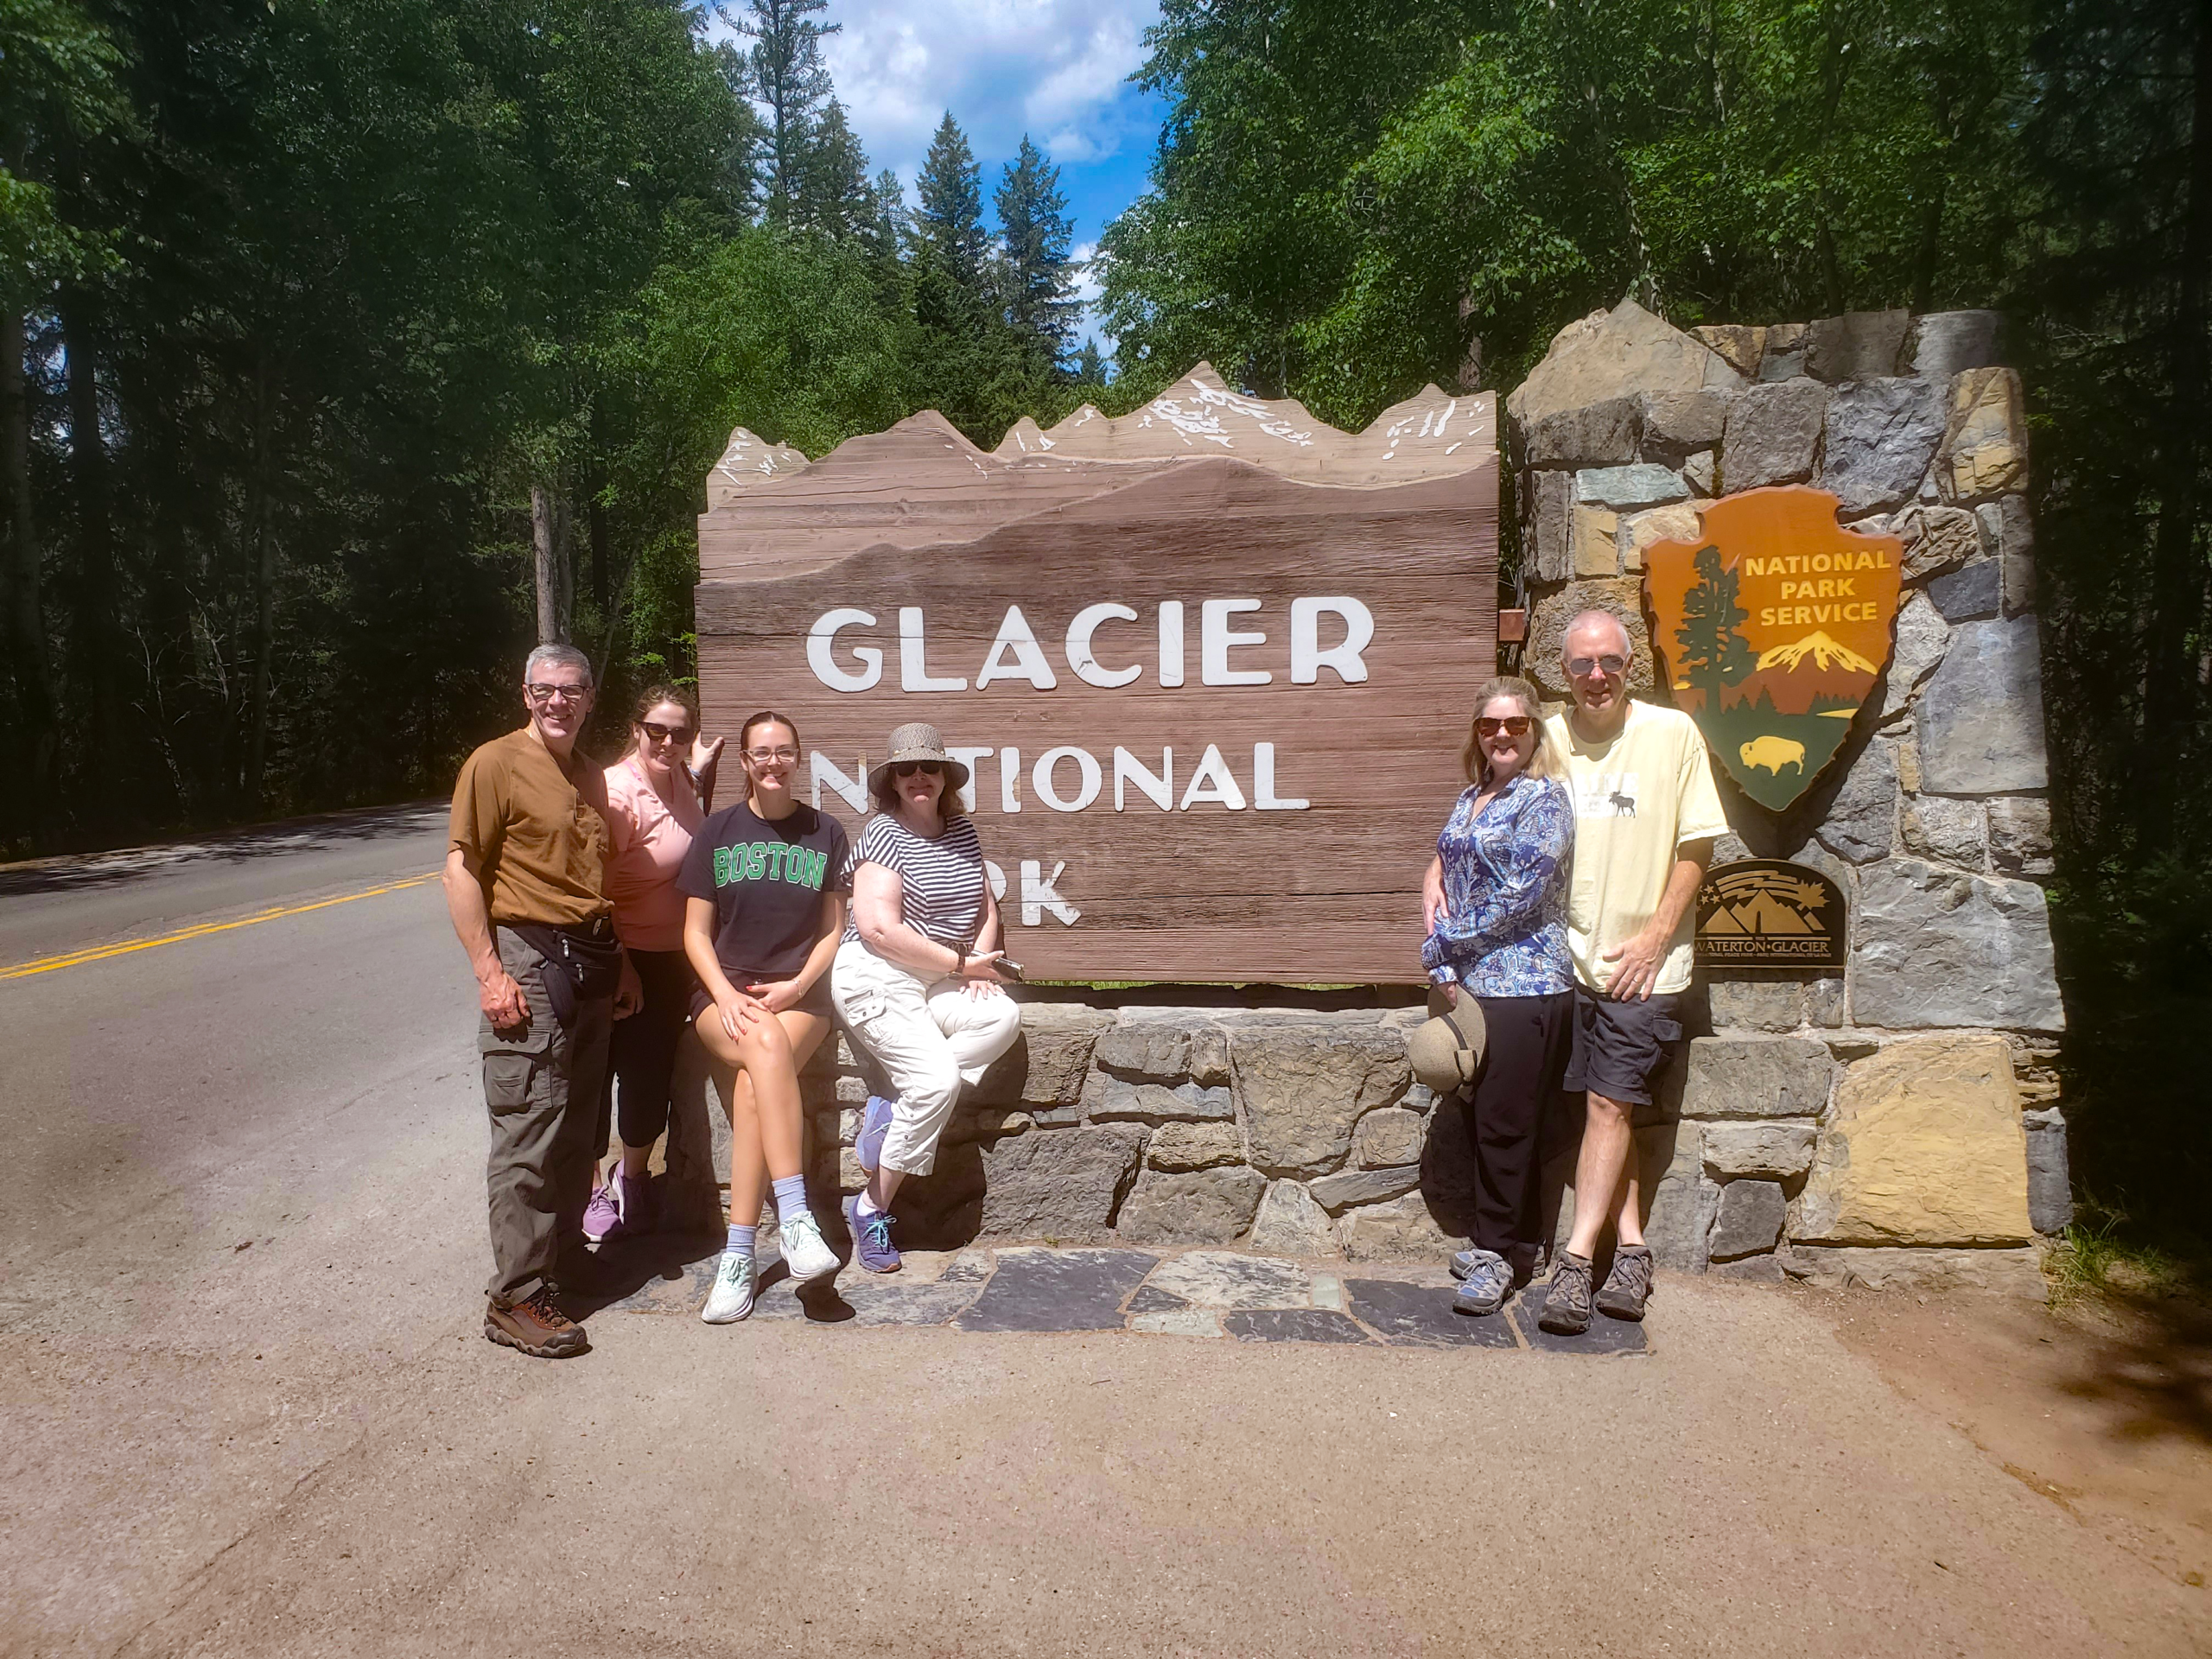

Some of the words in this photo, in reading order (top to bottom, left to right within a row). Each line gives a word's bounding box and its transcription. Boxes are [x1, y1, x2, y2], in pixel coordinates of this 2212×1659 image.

[1745, 551, 1891, 575] NATIONAL
[1782, 578, 1855, 599] PARK
[1761, 602, 1877, 626] SERVICE
[806, 596, 1375, 692] GLACIER
[810, 742, 1310, 814] NTIONAL
[713, 842, 827, 892] BOSTON
